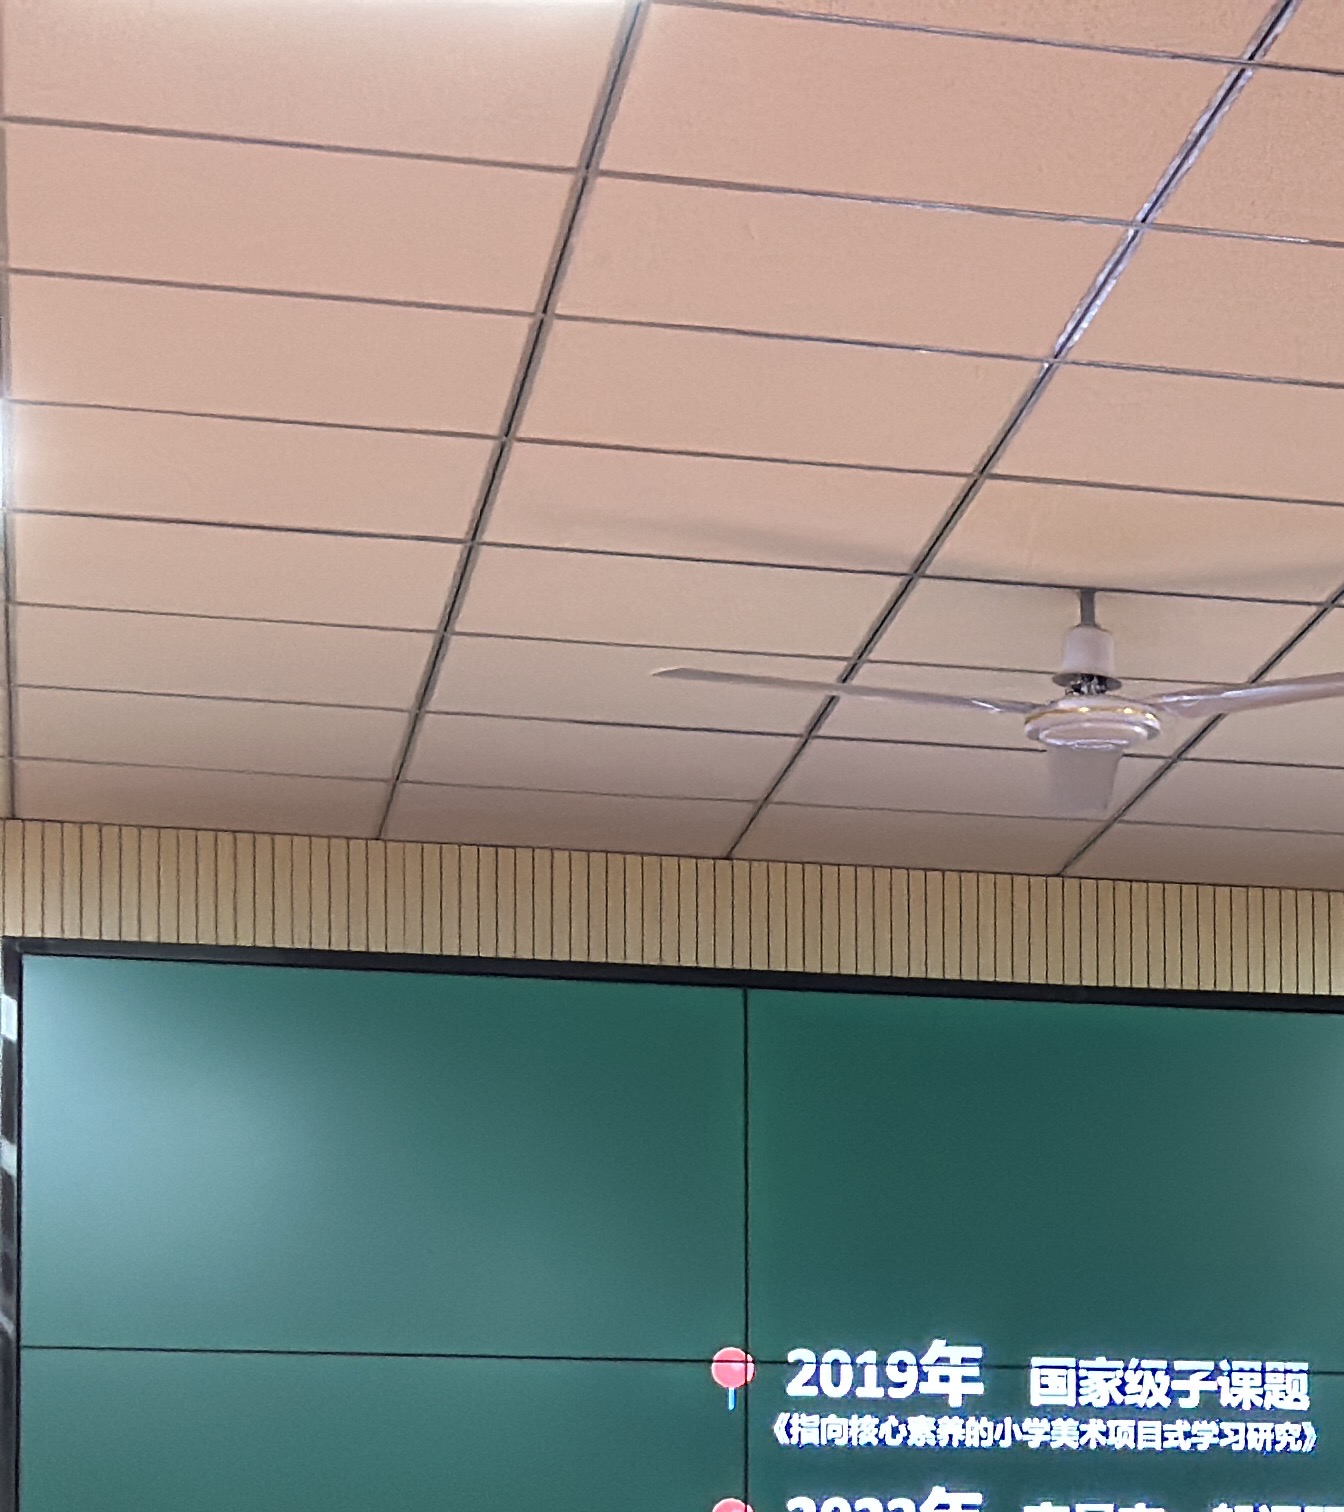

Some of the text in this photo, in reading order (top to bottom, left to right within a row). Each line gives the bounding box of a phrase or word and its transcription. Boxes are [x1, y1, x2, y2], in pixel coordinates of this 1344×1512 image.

[786, 1340, 1312, 1412] 2019年 国家级子课题
[773, 1412, 1318, 1454] 《指向核心素养的小学美术项目式学习研究》
